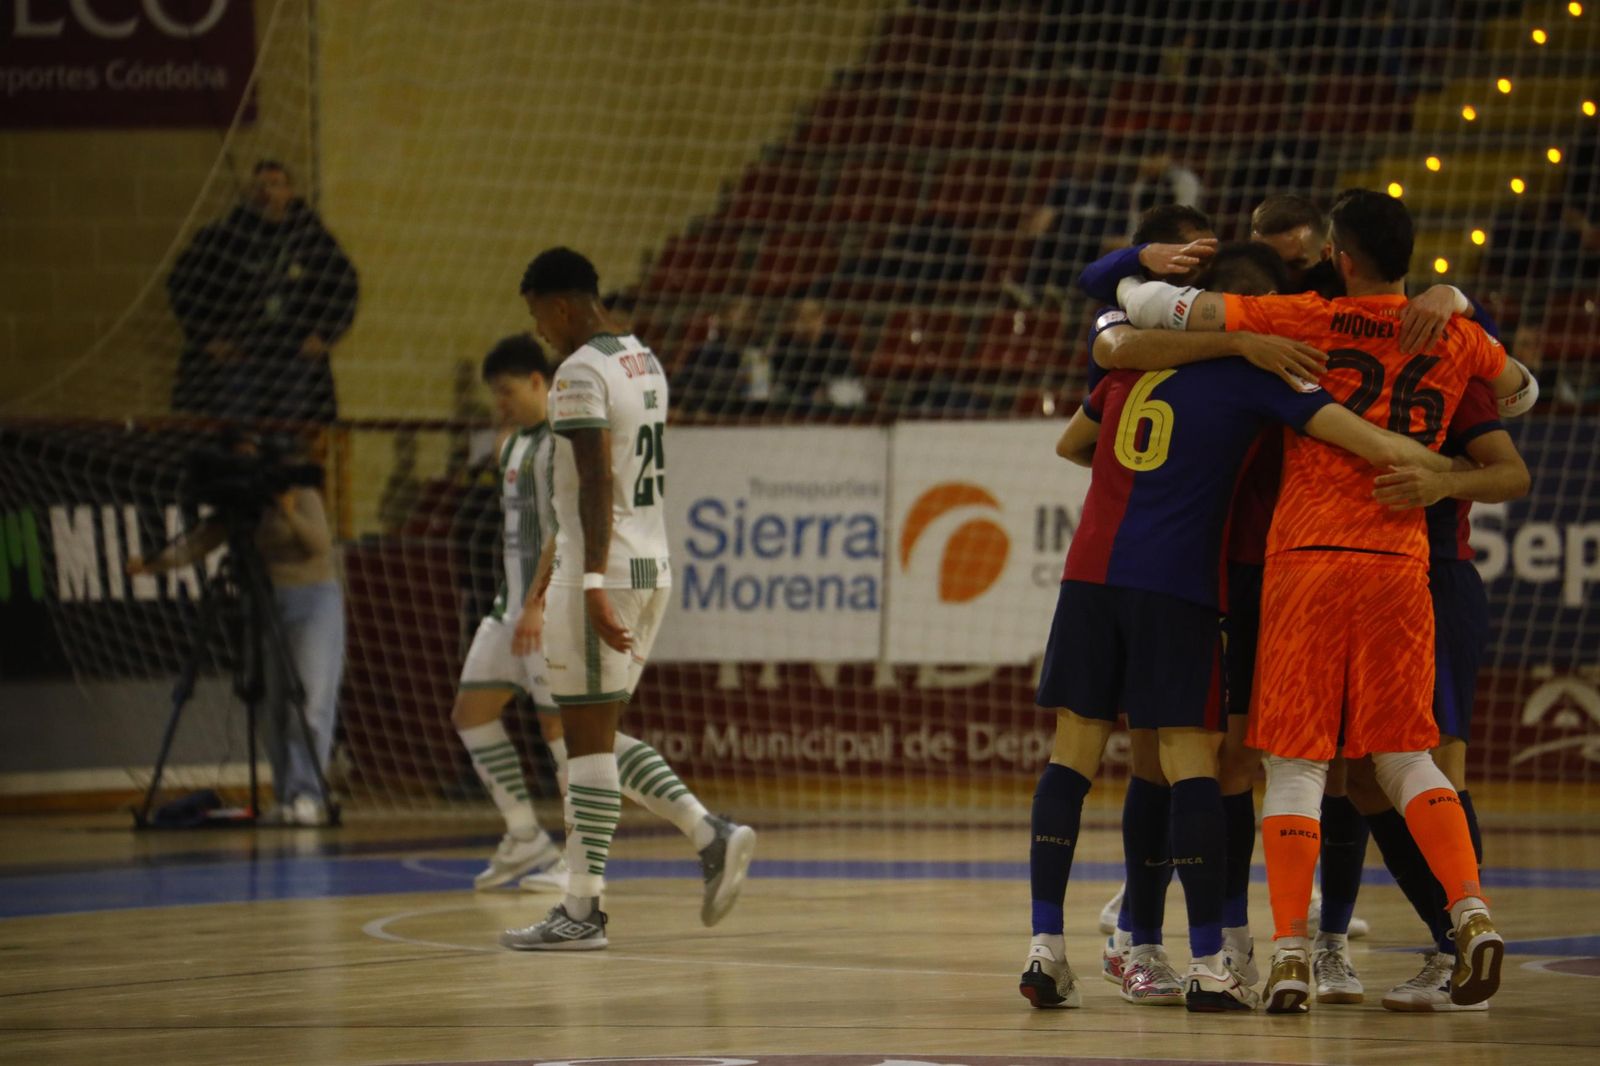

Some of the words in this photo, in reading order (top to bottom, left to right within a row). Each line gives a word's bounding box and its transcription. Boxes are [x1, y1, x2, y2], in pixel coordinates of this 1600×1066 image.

[105, 57, 229, 90] Córdoba
[1330, 311, 1395, 340] MIQUEL
[1114, 370, 1177, 472] 6
[1326, 349, 1445, 446] 26
[685, 497, 880, 560] Sierra
[682, 562, 878, 613] Morena
[702, 721, 891, 769] Municipal
[901, 722, 953, 761] de
